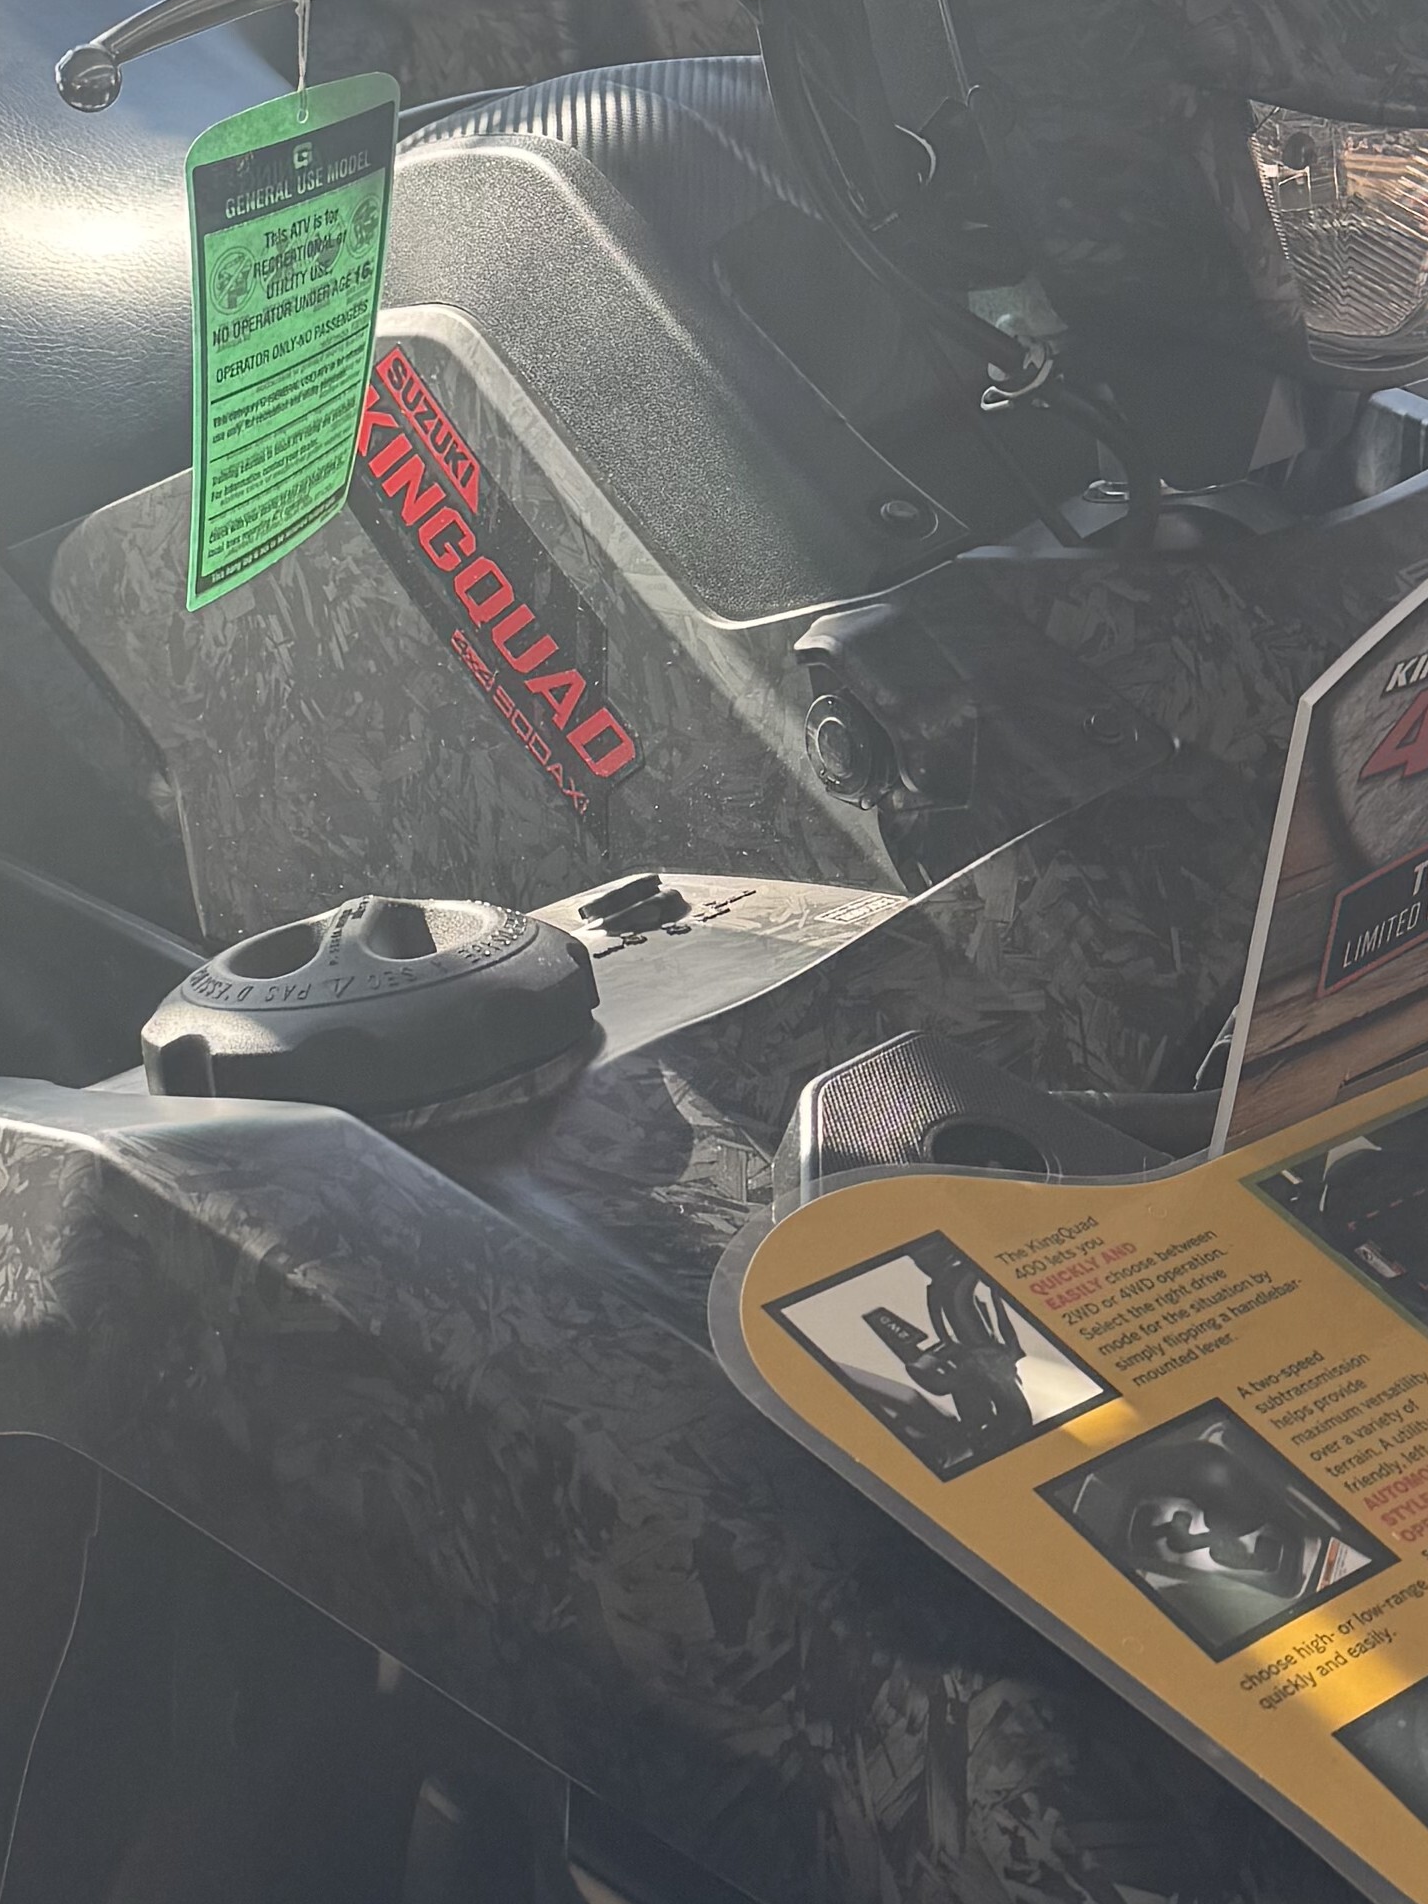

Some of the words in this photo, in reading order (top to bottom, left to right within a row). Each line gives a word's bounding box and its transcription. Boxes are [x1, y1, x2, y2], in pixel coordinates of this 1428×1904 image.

[225, 176, 292, 222] GENERAL
[296, 165, 324, 195] USE
[326, 148, 372, 183] MODEL
[253, 230, 334, 282] RECREATIONAL
[263, 223, 288, 252] This
[290, 215, 310, 241] ATV
[312, 211, 322, 231] is
[324, 203, 339, 226] for
[212, 323, 229, 350] NO
[233, 295, 292, 341] OPERATOR
[294, 280, 331, 314] UNDER
[332, 270, 352, 297] AGE
[265, 266, 307, 302] UTILITY
[216, 345, 269, 388] OPERATOR
[314, 297, 368, 340] PASSENGERS
[387, 355, 476, 490] SUZUKI
[357, 384, 637, 778] KINGQUAD
[1340, 898, 1423, 971] LIMITED
[993, 1245, 1031, 1267] The
[1022, 1213, 1103, 1255] KingQuad
[1009, 1258, 1050, 1281] 400
[1042, 1245, 1078, 1267] lets
[1072, 1234, 1109, 1256] you
[1025, 1255, 1106, 1298] QUICKLY
[1096, 1239, 1140, 1264] AND
[1042, 1276, 1107, 1311] EASILY
[1100, 1254, 1159, 1286] choose
[1152, 1227, 1219, 1262] between
[1059, 1301, 1104, 1326] 2WD
[1098, 1294, 1122, 1310] or
[1114, 1276, 1158, 1301] 4WD
[1151, 1244, 1231, 1286] operation.
